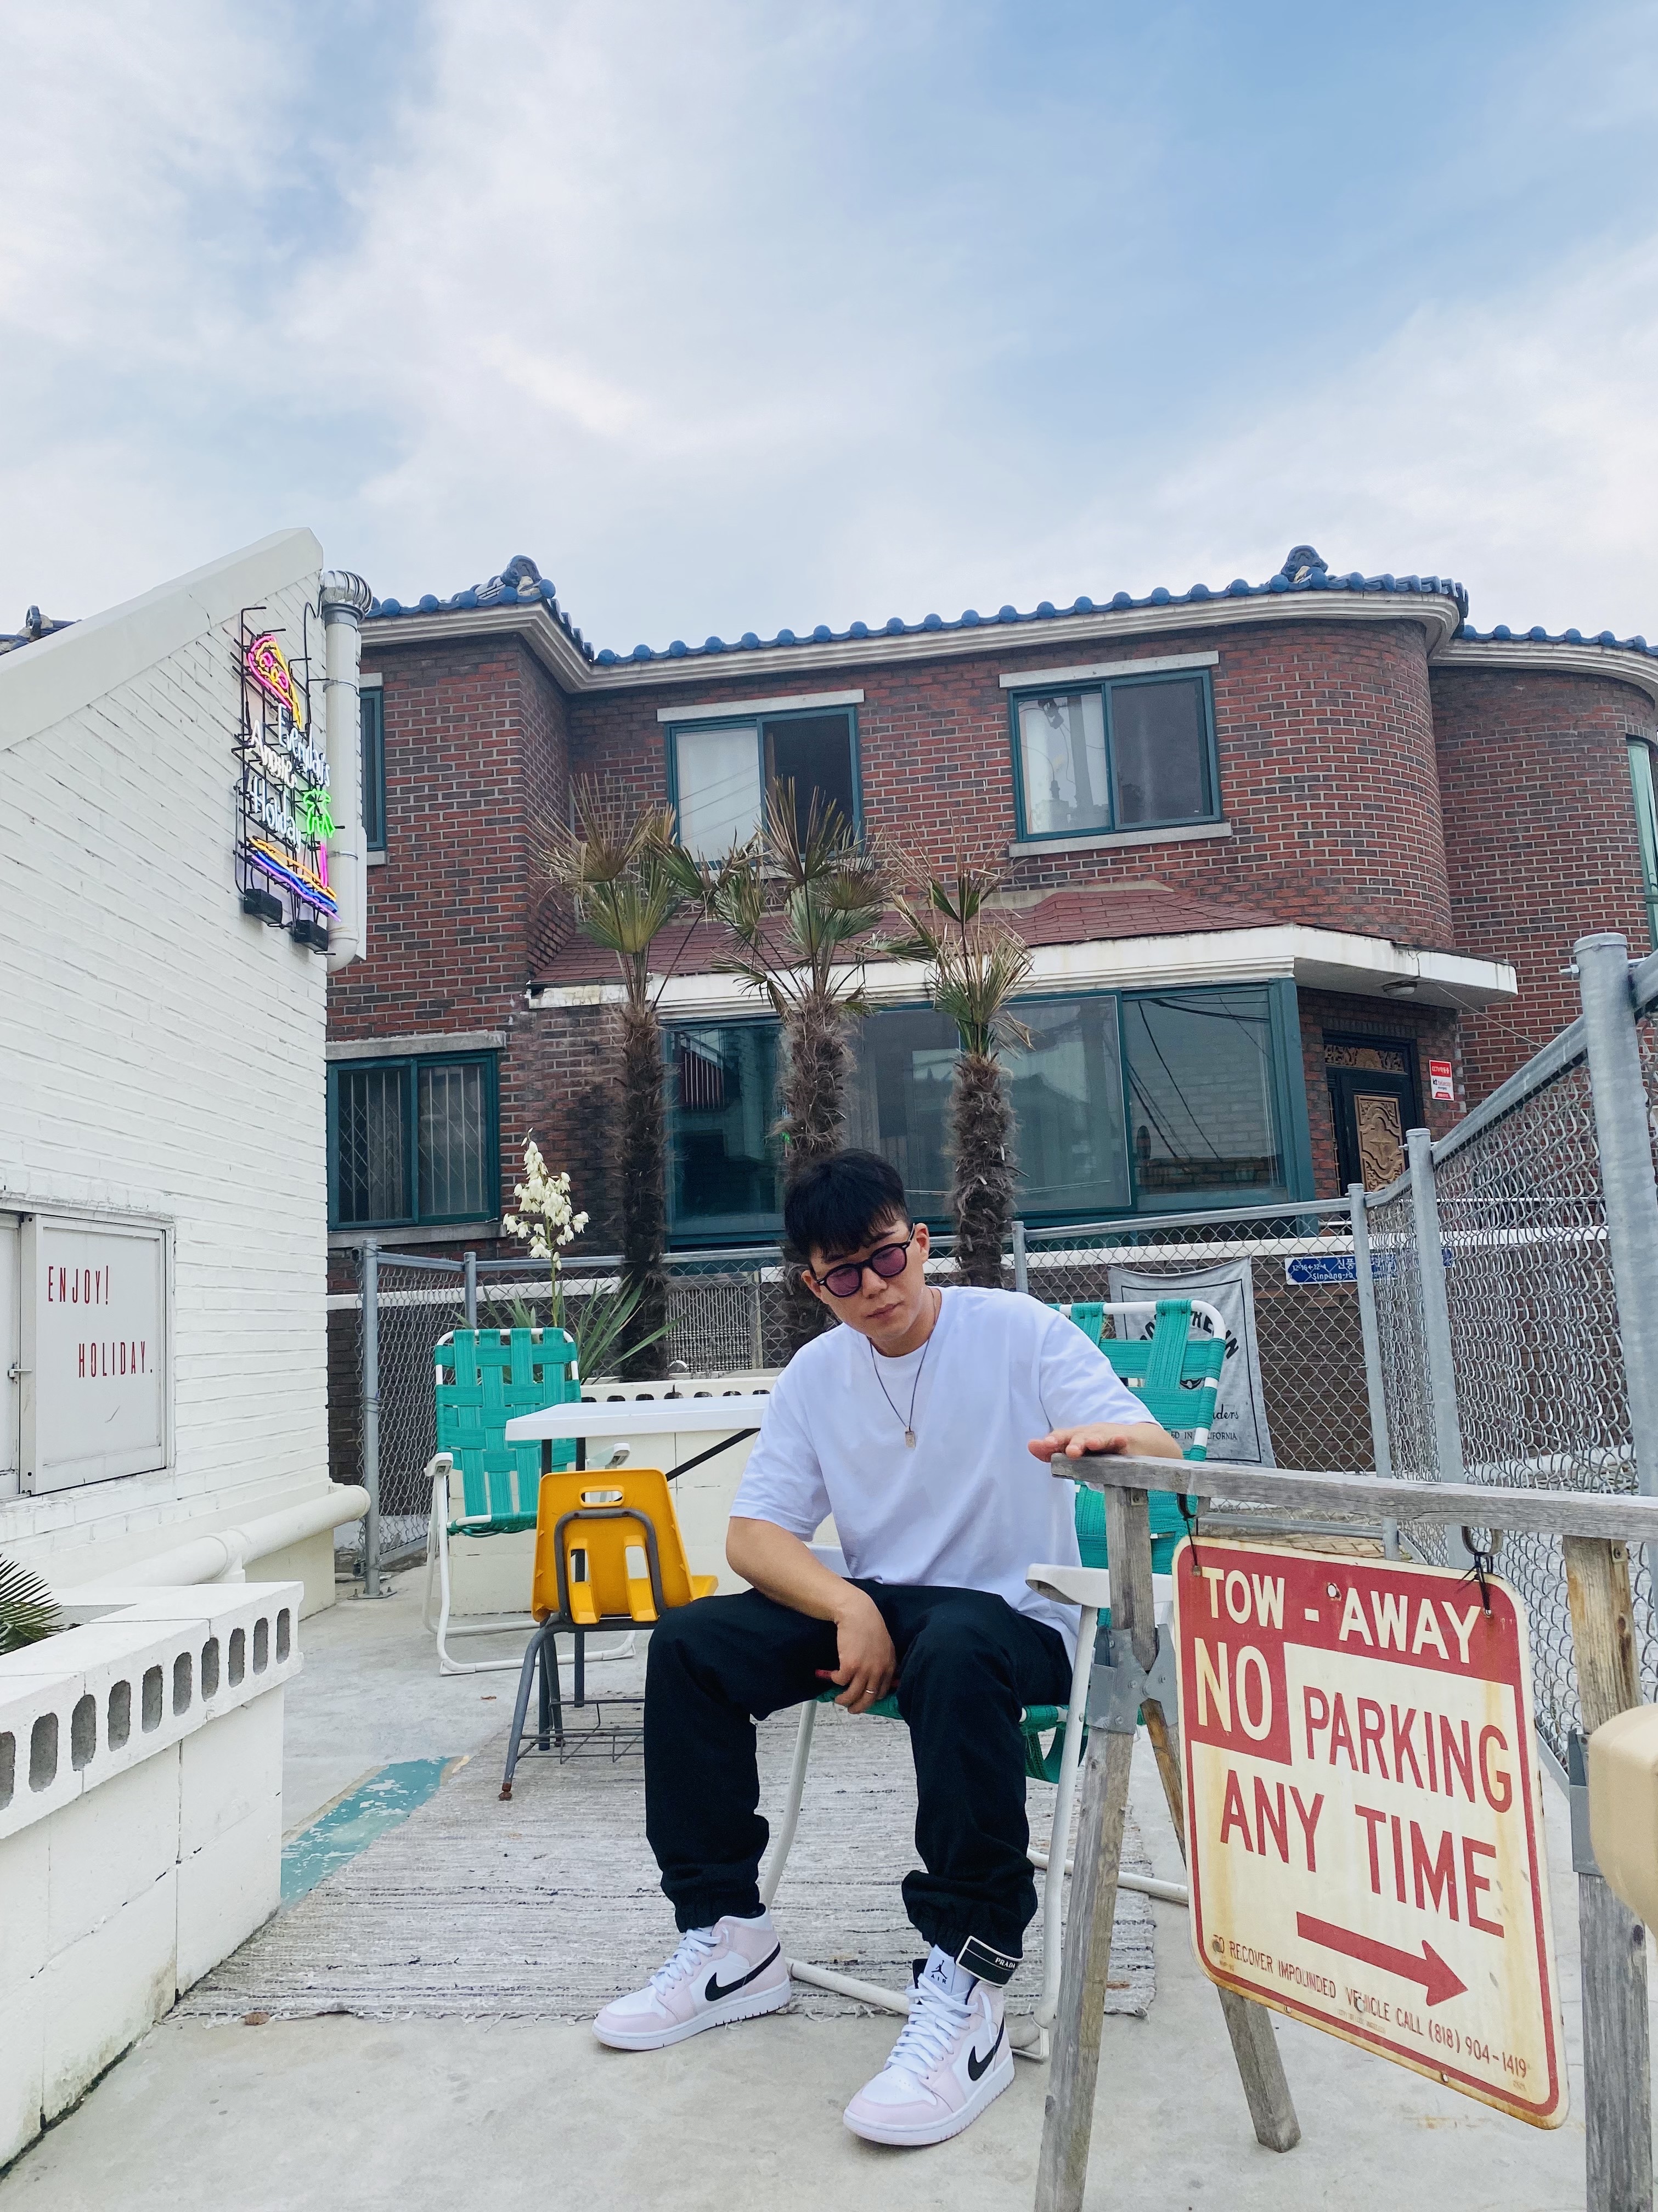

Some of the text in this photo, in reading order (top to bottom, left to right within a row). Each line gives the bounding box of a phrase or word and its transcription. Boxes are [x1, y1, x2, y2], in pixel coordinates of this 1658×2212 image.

[249, 776, 302, 853] Holiday
[48, 1265, 108, 1305] ENJOY!
[79, 1341, 153, 1378] HOLIDAY.
[1202, 1566, 1285, 1630] TOW
[1339, 1587, 1481, 1664] AWAY
[1194, 1637, 1513, 1813] NO PARKING
[1220, 1769, 1504, 1938] ANY TIME
[931, 1974, 946, 1984] AIR
[1229, 1940, 1273, 1974] RECOVER
[1278, 1959, 1336, 1999] IMPOUNDED
[1396, 2007, 1424, 2036] CALL
[1428, 2019, 1460, 2053] (818)
[1465, 2036, 1527, 2078] 904-1419
